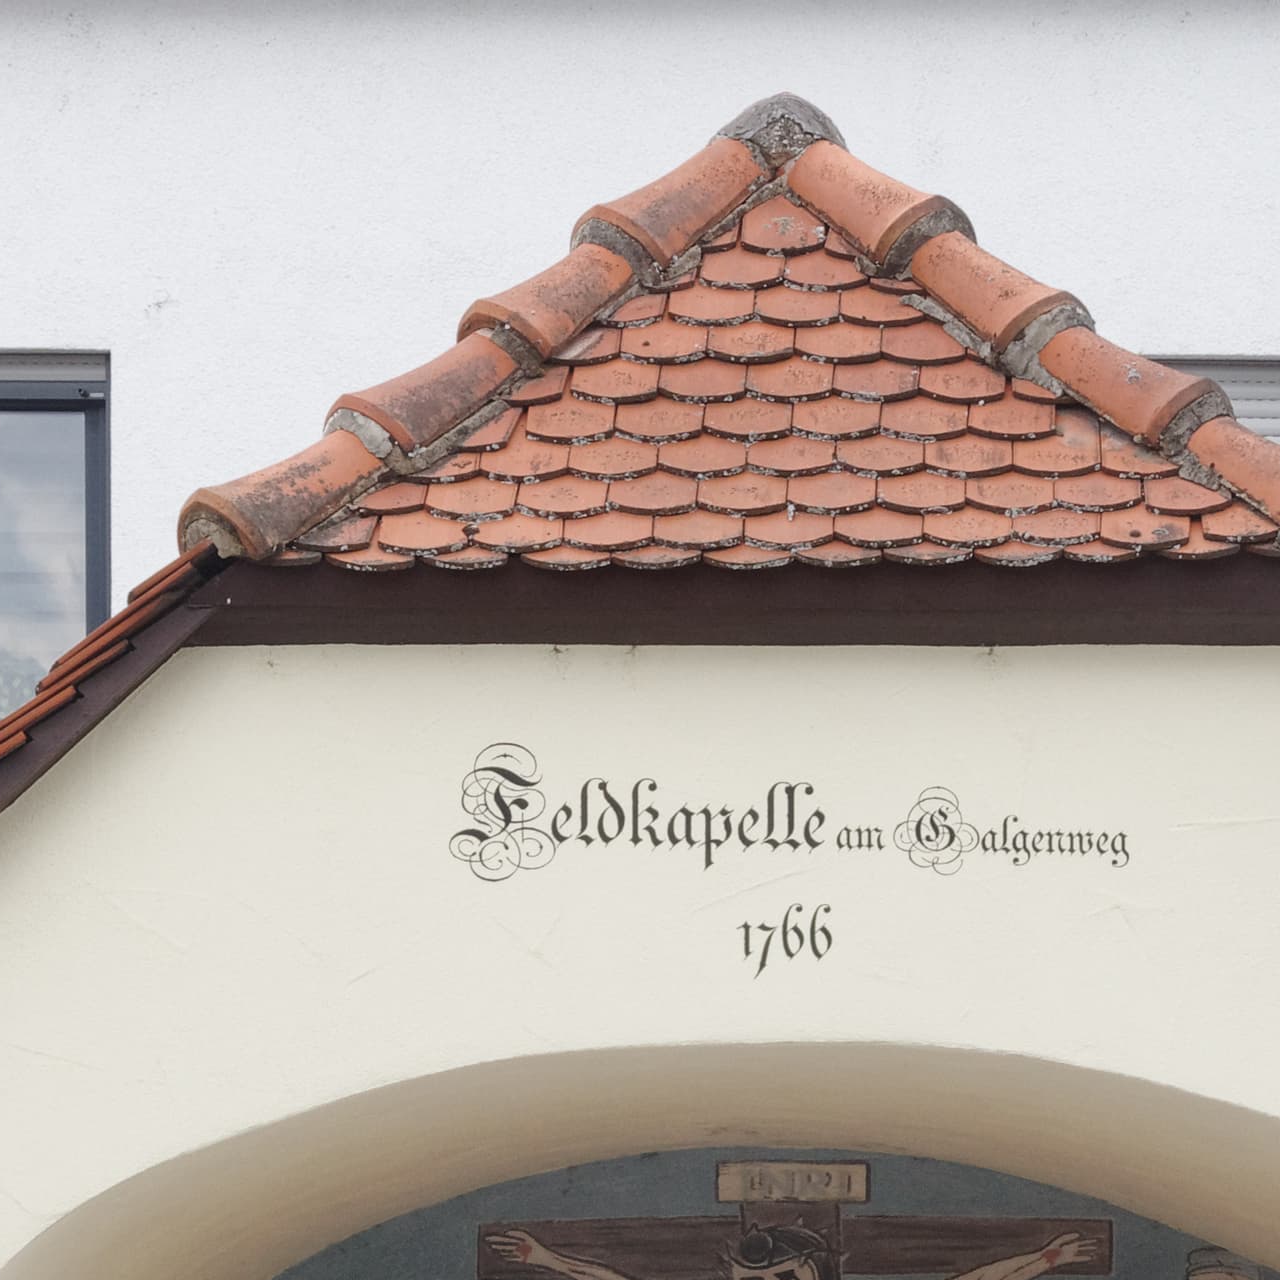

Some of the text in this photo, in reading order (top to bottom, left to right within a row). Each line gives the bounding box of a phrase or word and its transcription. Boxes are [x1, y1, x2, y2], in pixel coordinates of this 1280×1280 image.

[449, 743, 1130, 882] Feldkapelle am Galgenweg
[736, 903, 833, 979] 1766
